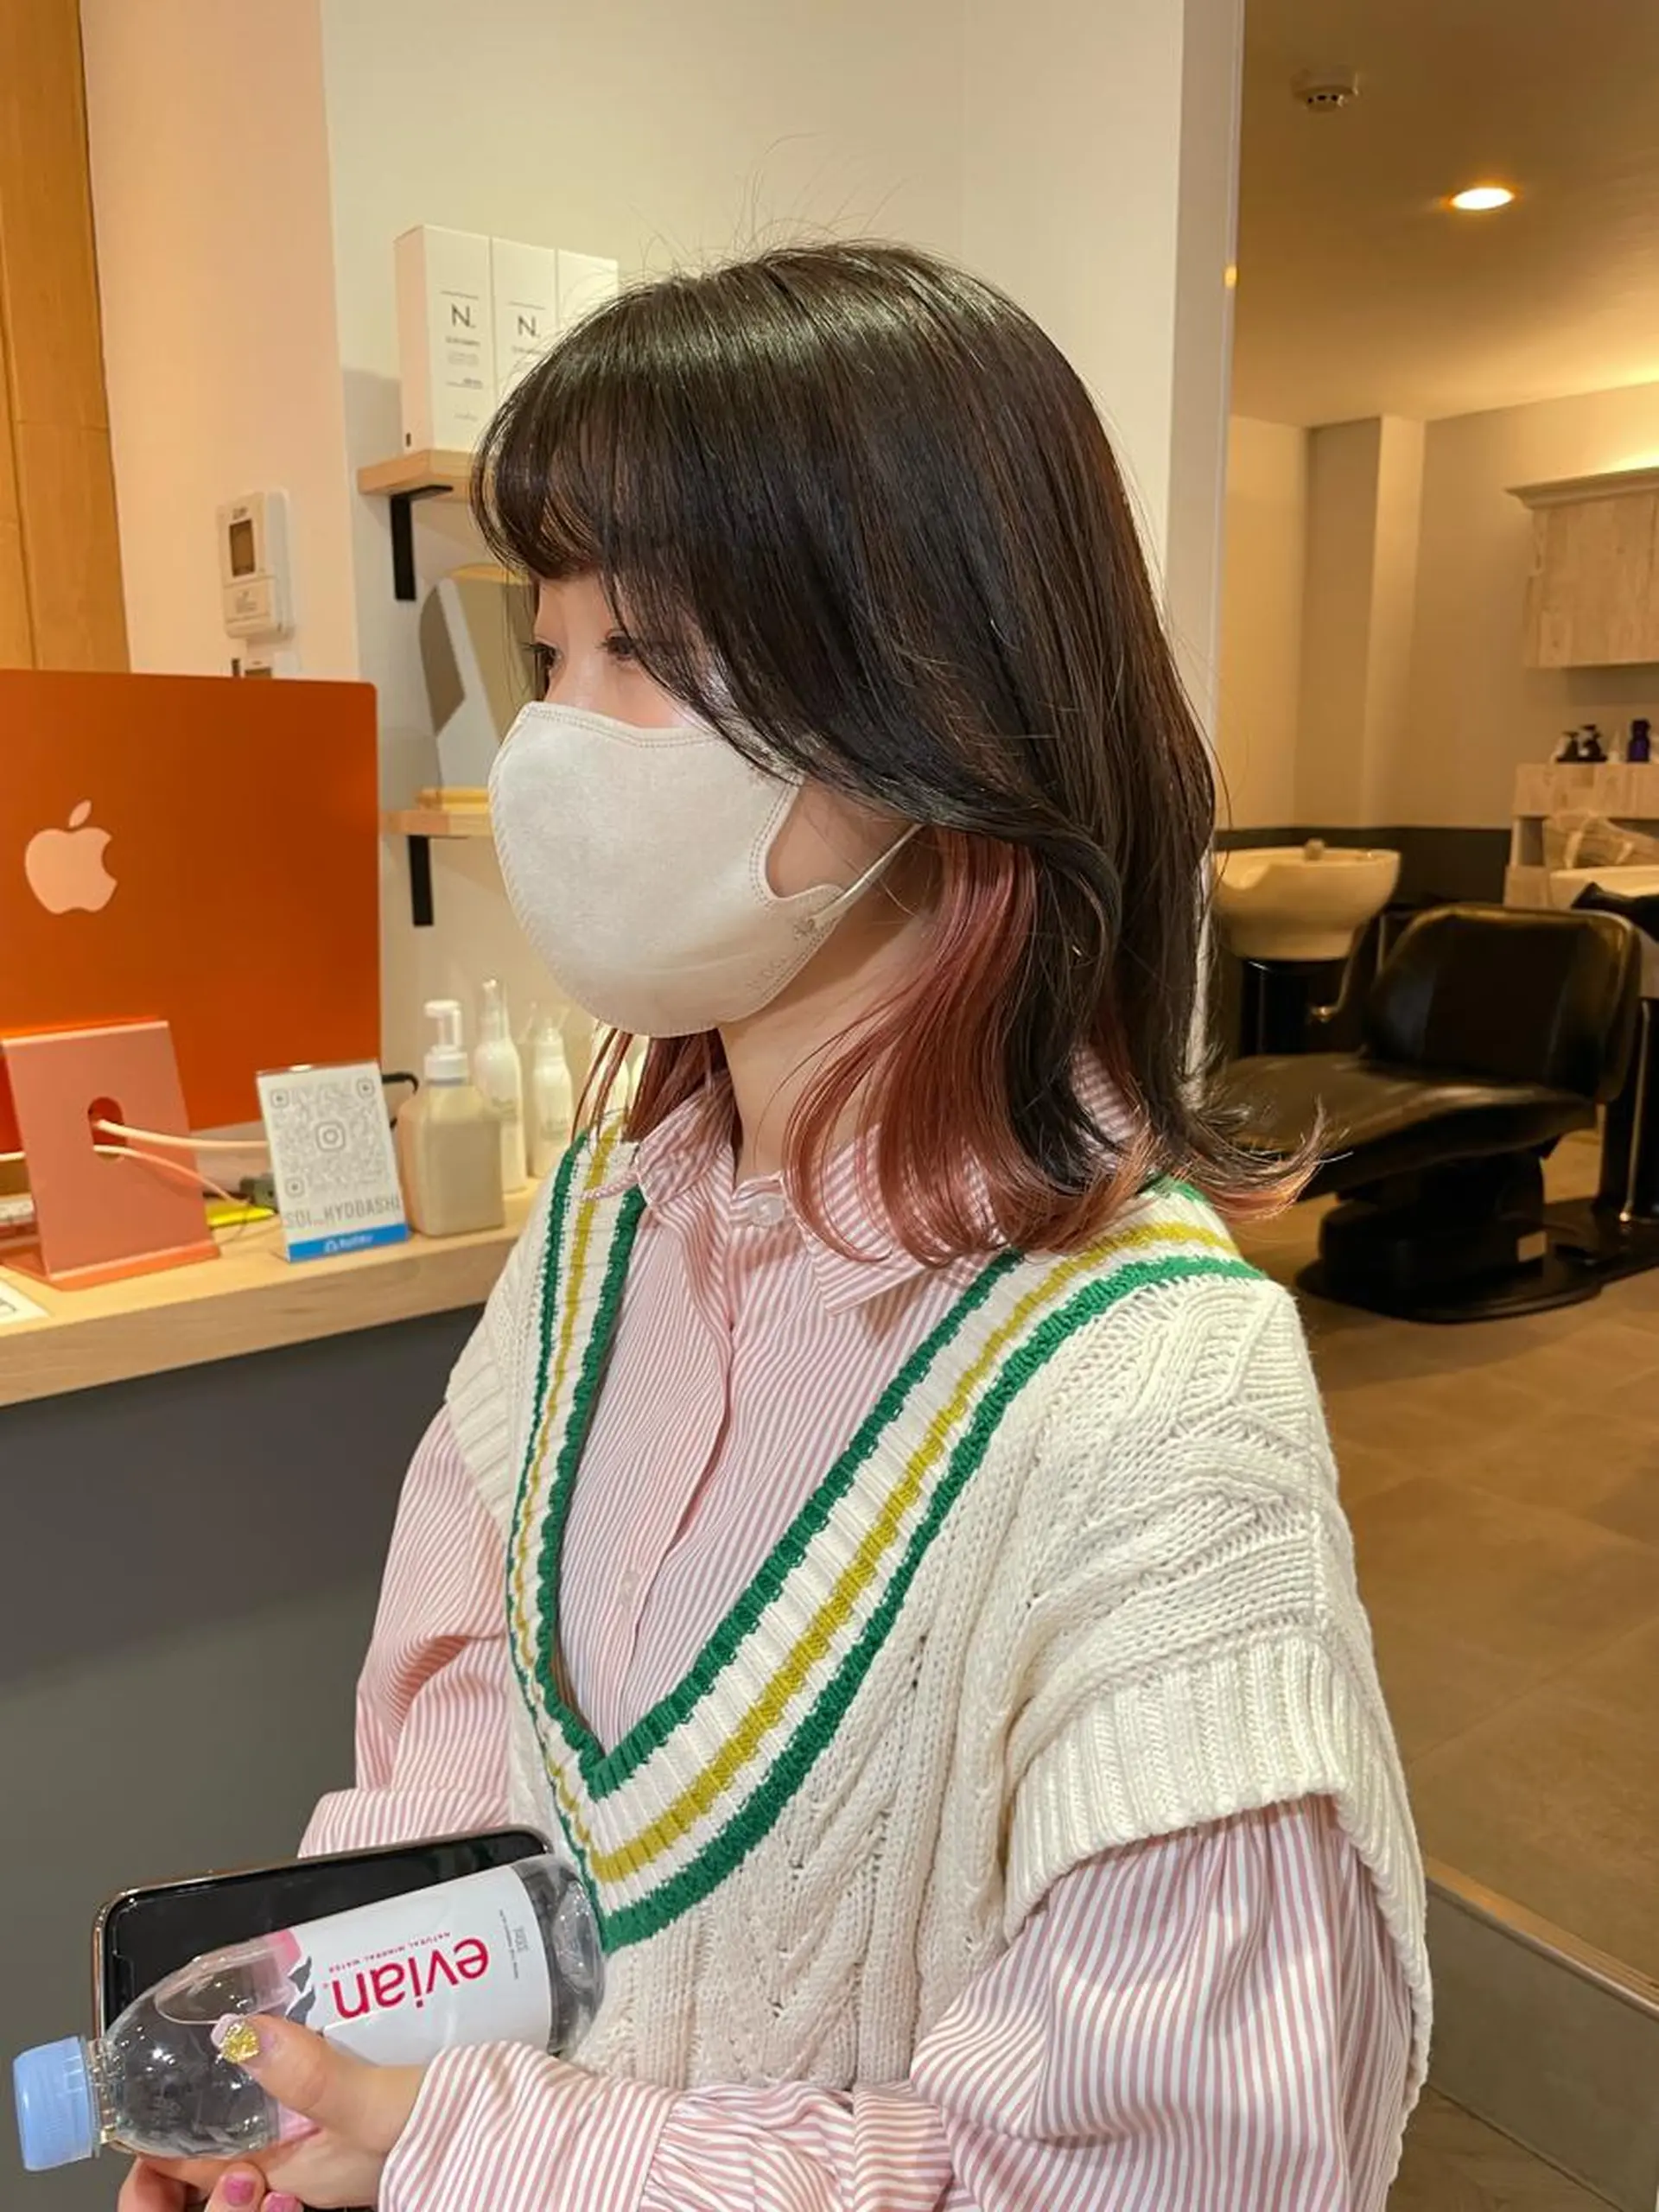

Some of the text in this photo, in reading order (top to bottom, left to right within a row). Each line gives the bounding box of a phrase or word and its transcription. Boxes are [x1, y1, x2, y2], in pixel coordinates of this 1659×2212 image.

[328, 1931, 451, 1973] NATURAL MINERAL WATER
